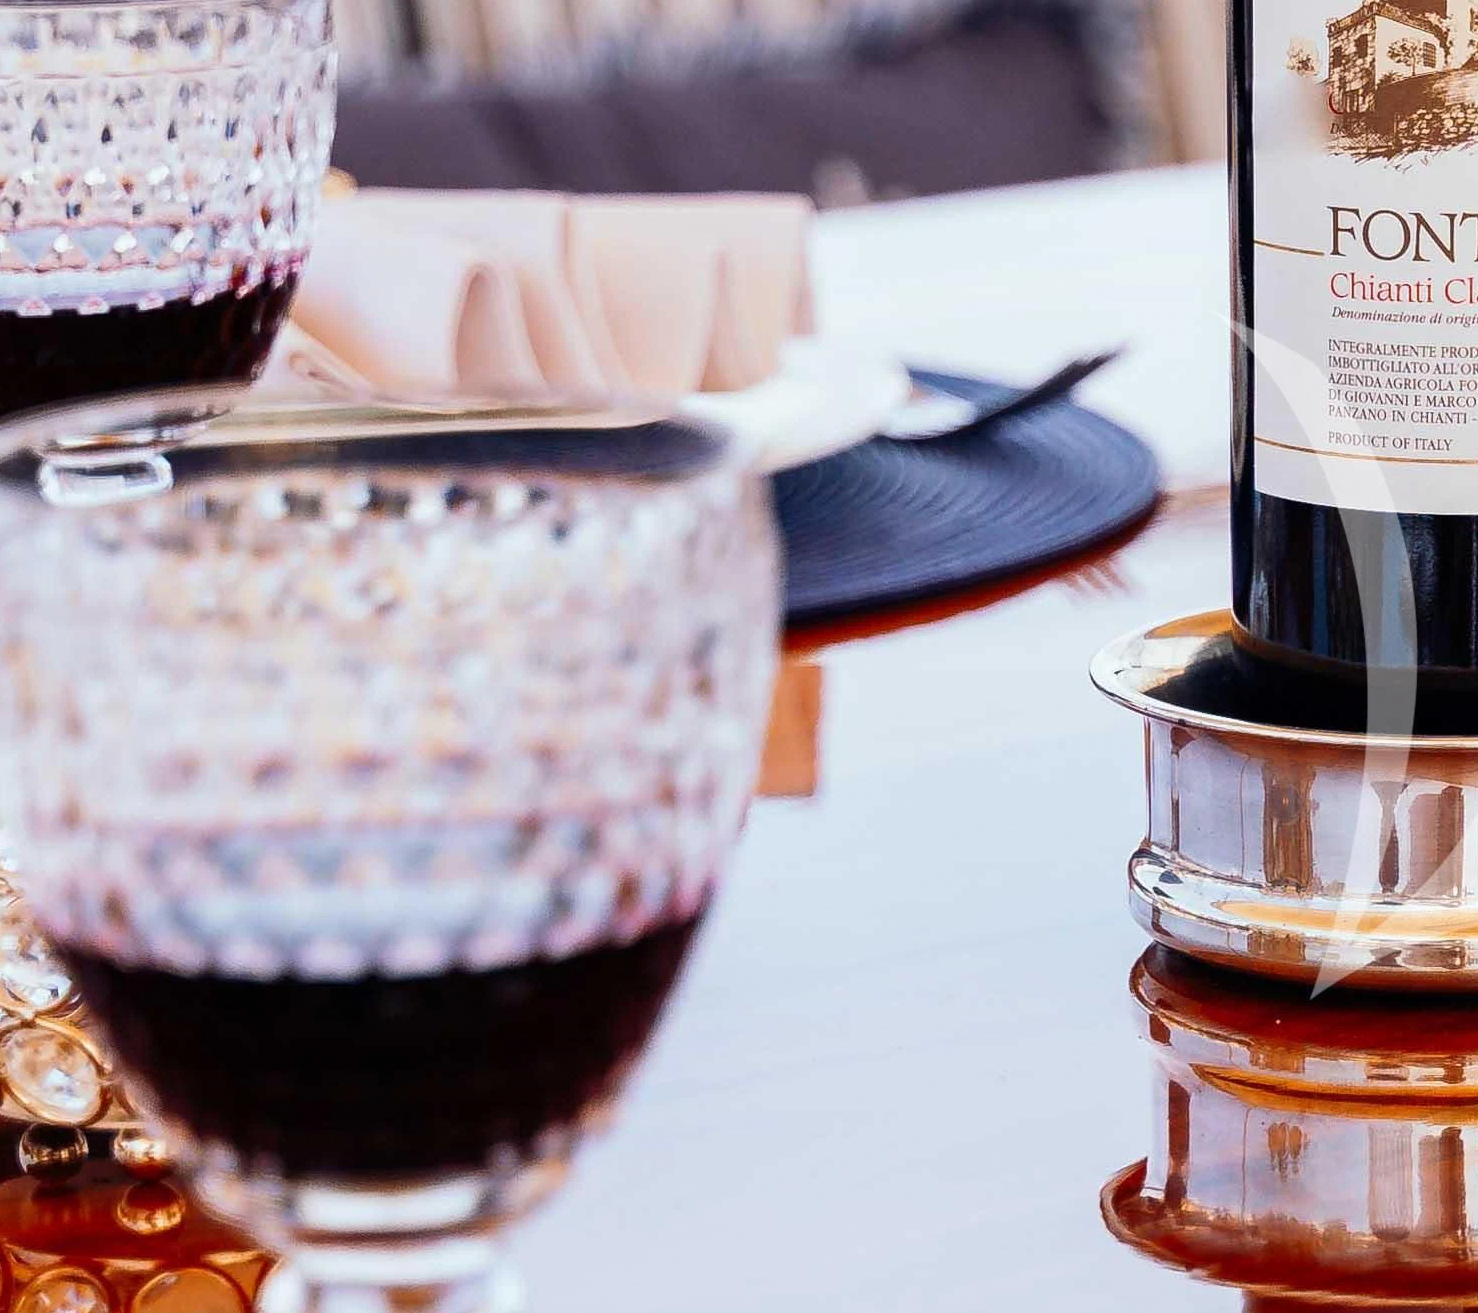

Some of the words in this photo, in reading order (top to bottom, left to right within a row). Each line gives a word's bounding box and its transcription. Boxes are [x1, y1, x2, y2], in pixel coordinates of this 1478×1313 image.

[1330, 271, 1433, 304] Chianti
[1332, 306, 1426, 324] Denominazione
[1430, 311, 1441, 324] di
[1328, 339, 1436, 358] INTEGRALMENTE
[1328, 355, 1430, 374] IMBOTTIGLIATO
[1328, 374, 1381, 389] AZIENDA
[1384, 377, 1454, 392] AGRICOLA
[1328, 389, 1341, 401] DI
[1345, 390, 1409, 407] GIOVANNI
[1414, 395, 1421, 407] E
[1425, 395, 1476, 408] MARCO
[1328, 404, 1387, 422] PANZANO
[1392, 410, 1406, 422] IN
[1410, 411, 1467, 424] CHIANTI
[1328, 431, 1388, 449] PRODUCT
[1392, 437, 1411, 450] OF
[1415, 438, 1454, 451] ITALY
